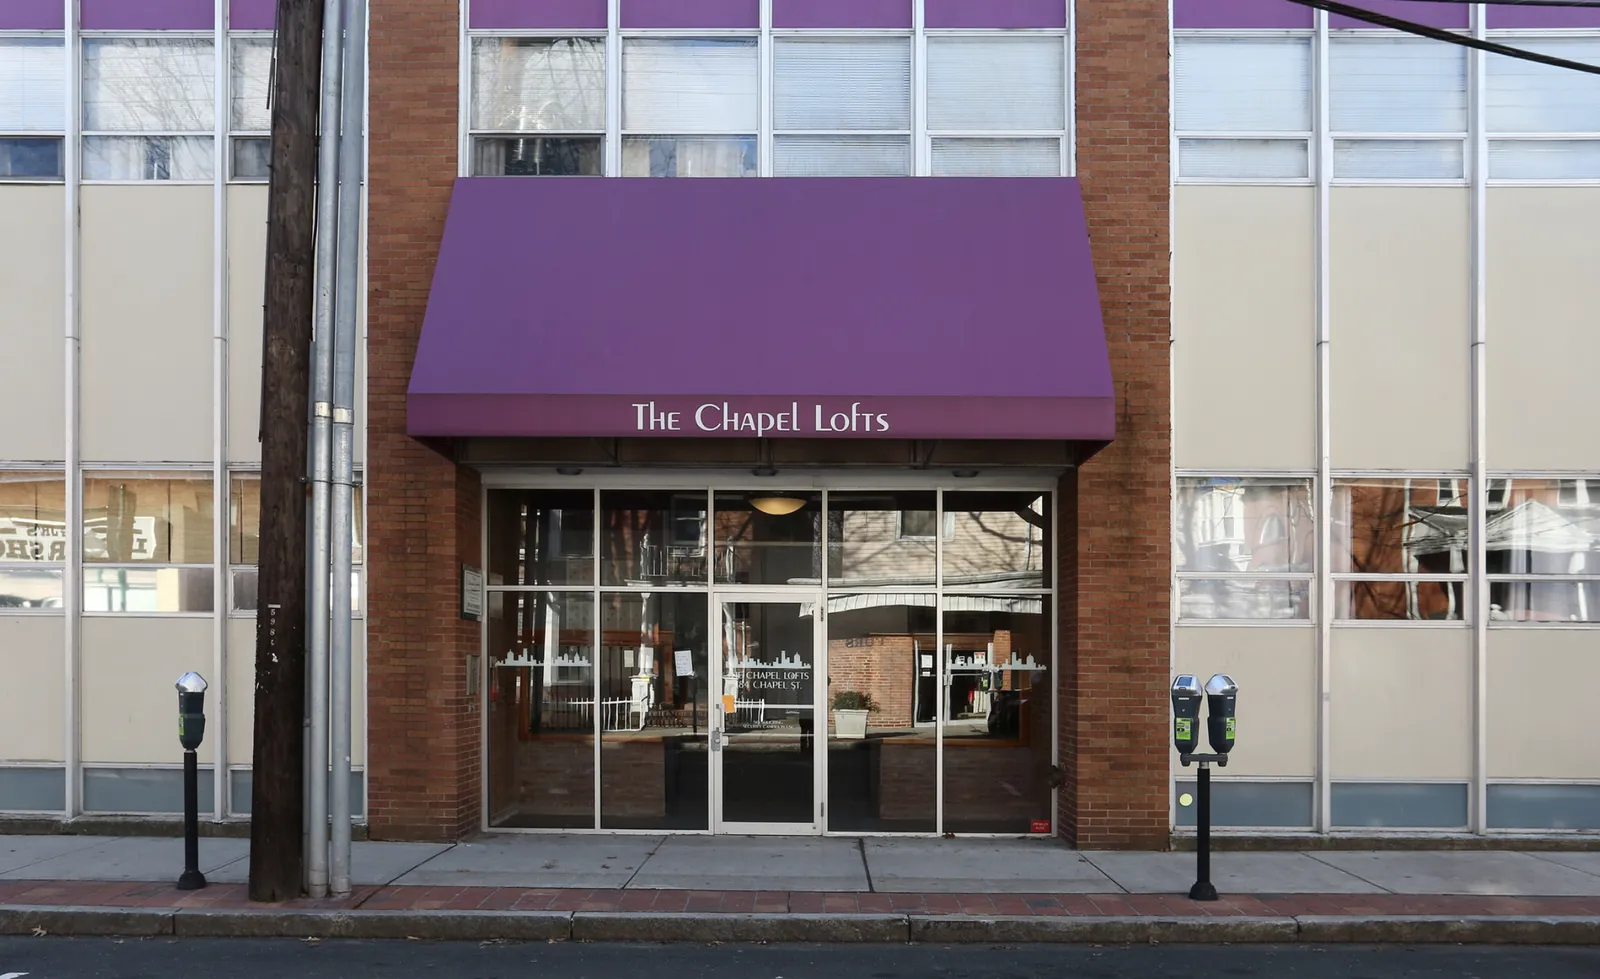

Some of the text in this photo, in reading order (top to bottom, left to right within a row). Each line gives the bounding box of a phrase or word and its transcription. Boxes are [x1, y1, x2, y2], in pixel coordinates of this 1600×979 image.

[632, 401, 890, 437] The Chapel Lofts
[746, 671, 780, 680] CHAPEL
[783, 671, 810, 680] LOFTS
[753, 681, 788, 689] CHAPEL
